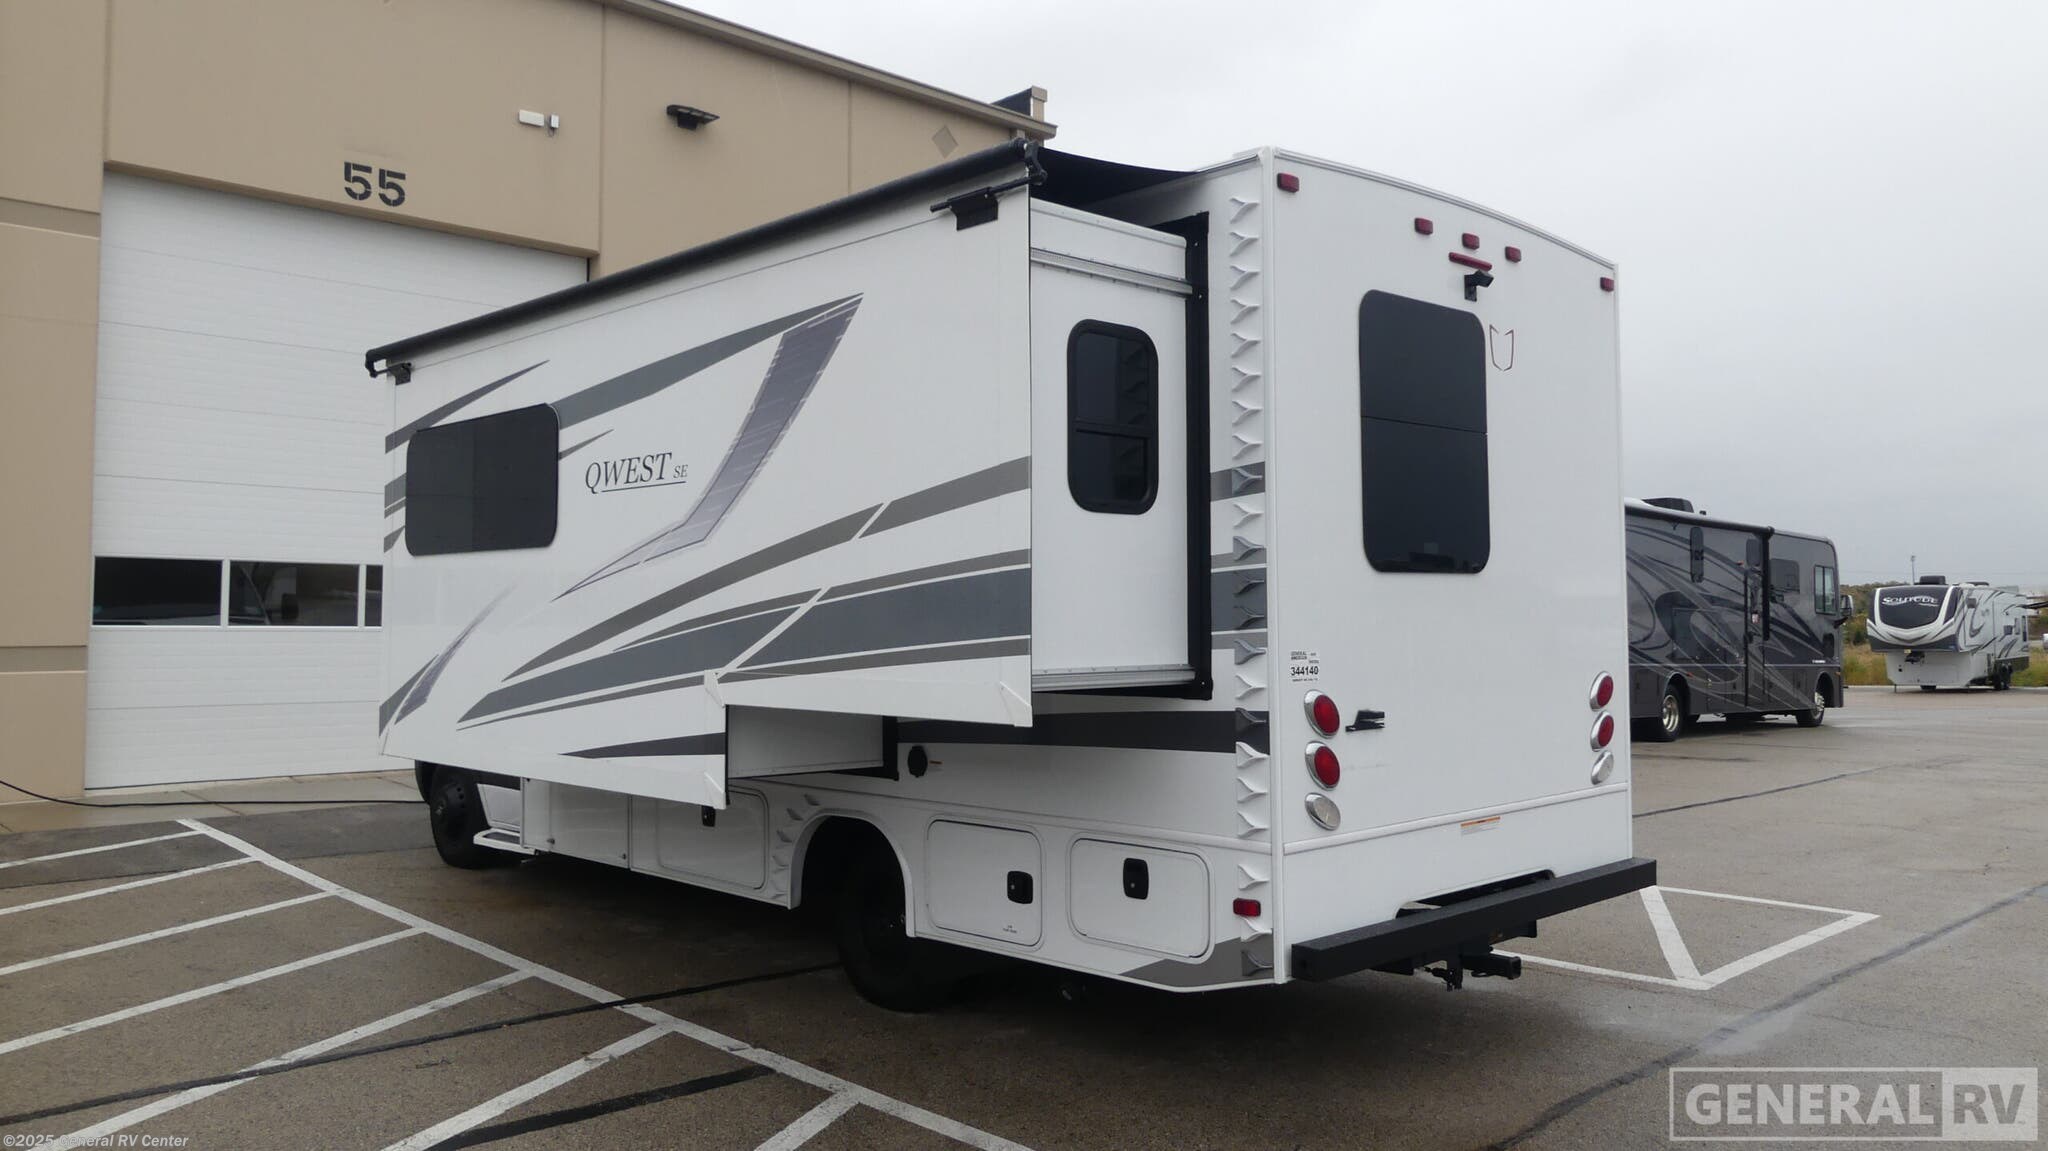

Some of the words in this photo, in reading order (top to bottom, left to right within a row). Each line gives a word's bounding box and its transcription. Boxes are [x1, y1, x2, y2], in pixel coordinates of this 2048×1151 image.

[344, 161, 406, 207] 55
[585, 452, 672, 494] QWEST
[673, 464, 689, 479] SE
[1290, 666, 1319, 676] 344140
